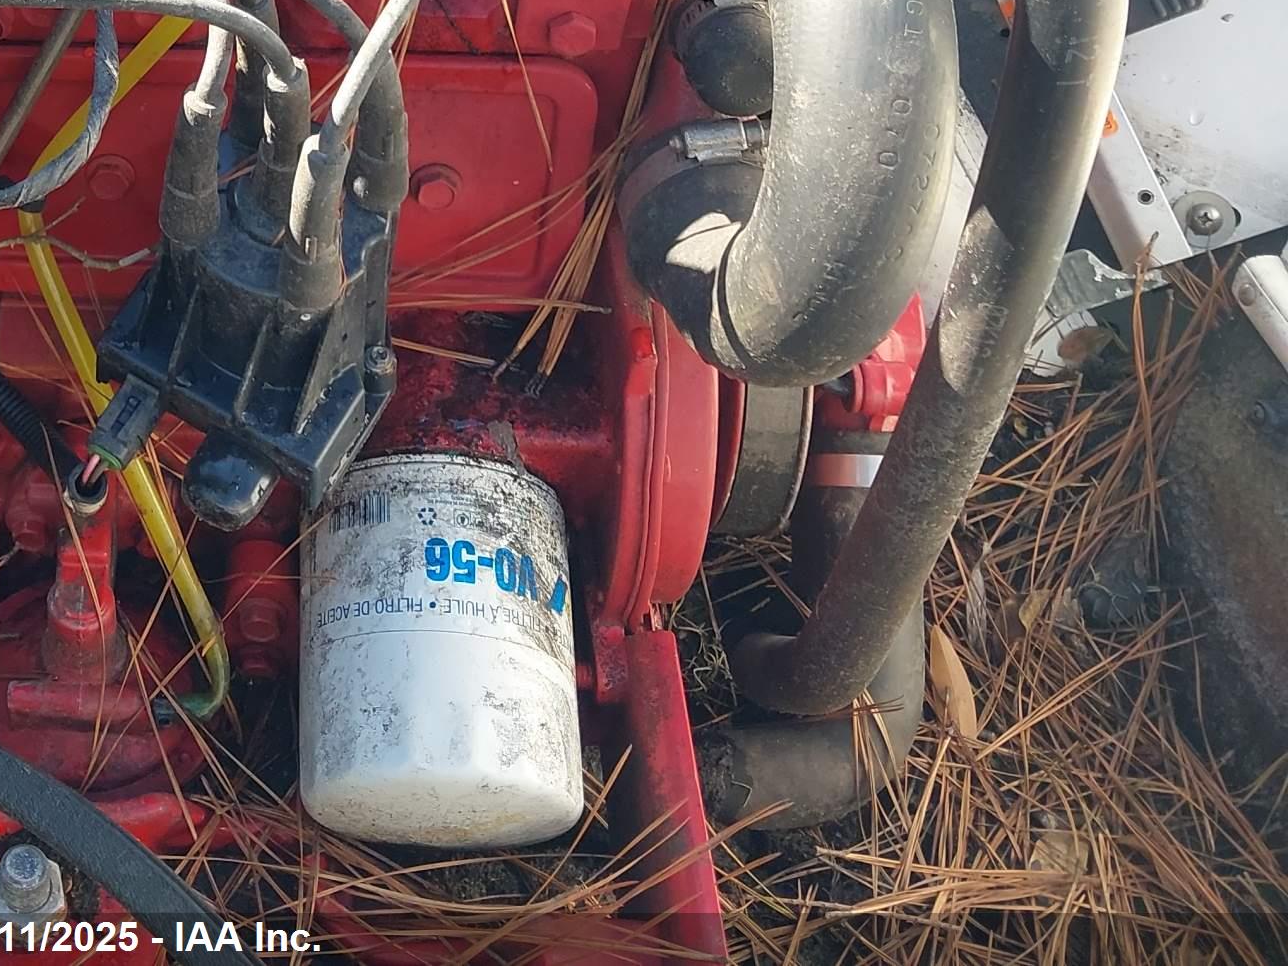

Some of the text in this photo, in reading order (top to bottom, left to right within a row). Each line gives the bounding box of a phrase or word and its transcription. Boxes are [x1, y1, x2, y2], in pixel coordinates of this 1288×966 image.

[353, 600, 371, 618] DE
[374, 596, 424, 615] FILTRO
[441, 598, 486, 619] HUILE
[316, 603, 352, 629] ACEITE
